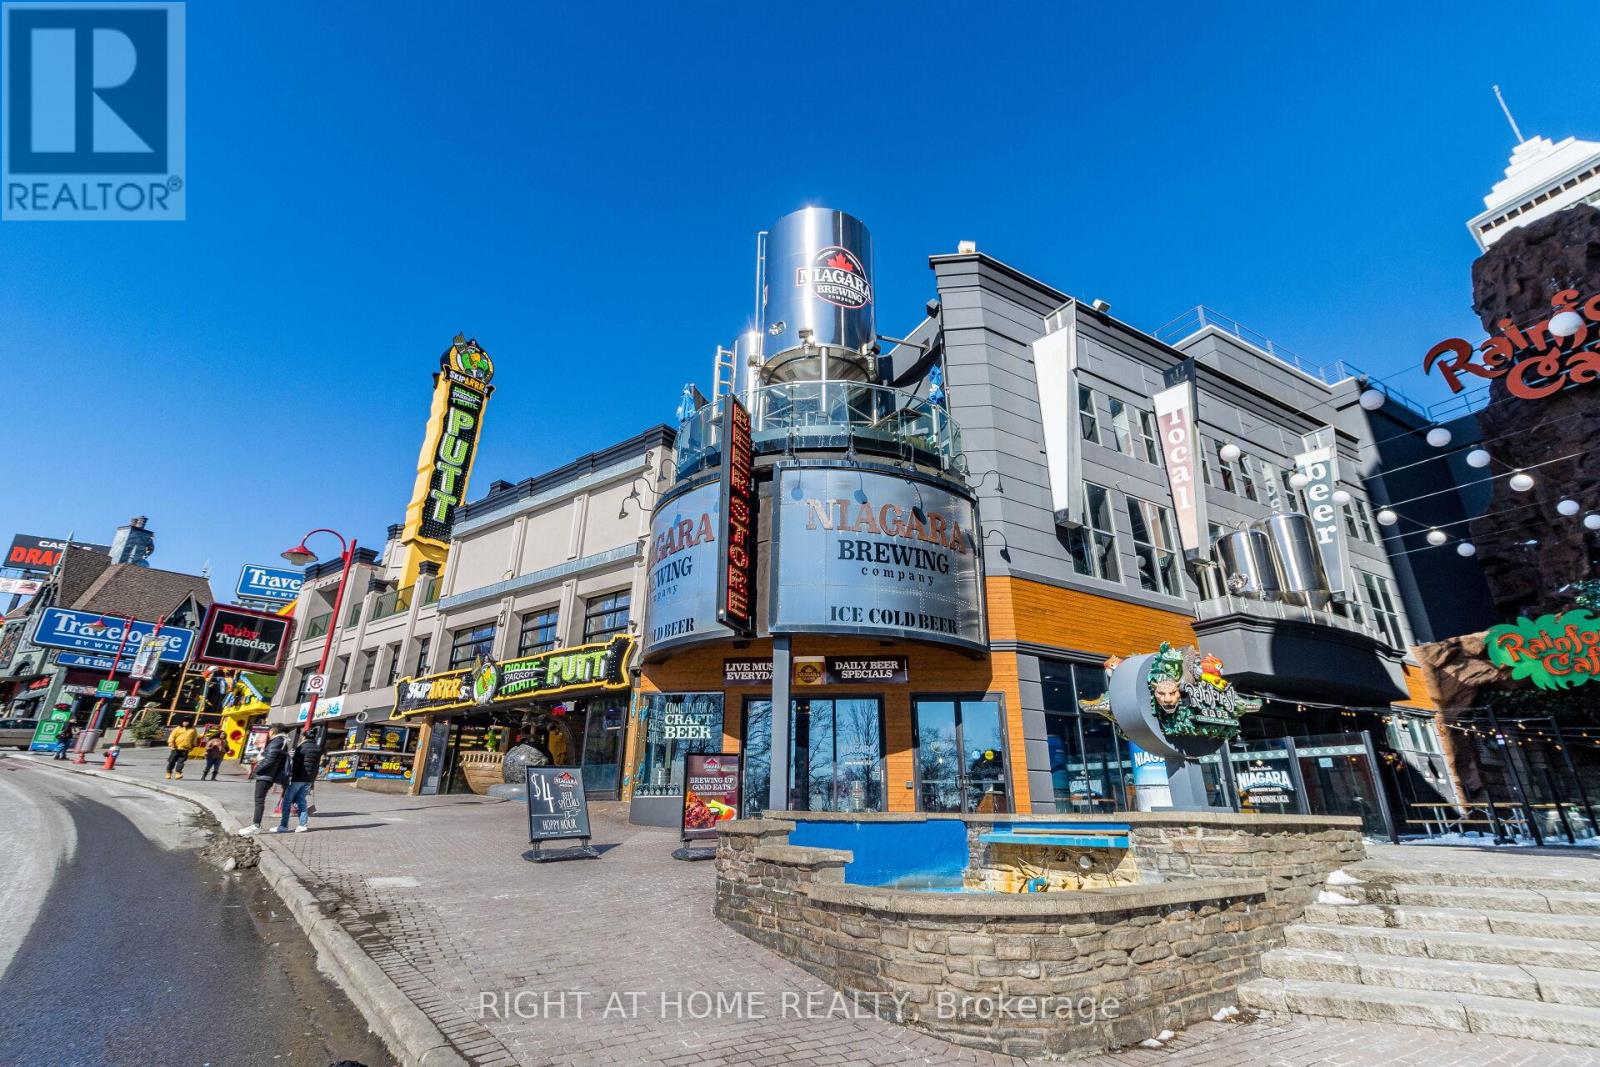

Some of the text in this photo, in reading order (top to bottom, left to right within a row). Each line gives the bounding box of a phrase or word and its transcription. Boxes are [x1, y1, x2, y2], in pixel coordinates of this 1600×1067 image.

[800, 268, 871, 300] NIAGARA
[817, 285, 863, 302] BREWING
[431, 406, 474, 523] PUTT
[1167, 407, 1191, 510] local
[1305, 461, 1337, 545] beer
[806, 498, 967, 554] NIAGARA
[728, 496, 749, 620] STORE
[838, 539, 950, 575] BREWING
[861, 566, 935, 586] company
[664, 617, 695, 637] BEER
[831, 605, 958, 634] ICE COLD BEER
[223, 623, 261, 640] Ruby
[216, 632, 276, 653] Tuesday
[75, 656, 92, 665] At
[93, 658, 111, 668] the
[546, 650, 612, 685] PUTT
[725, 663, 752, 672] LIVE
[835, 661, 899, 670] DAILY BEER
[841, 669, 893, 679] SPECIALS
[665, 702, 684, 713] COME
[685, 702, 695, 713] IN
[665, 714, 714, 725] CRAFT
[664, 725, 713, 739] BEER
[381, 762, 400, 770] BIG
[1236, 770, 1295, 792] NIAGARA
